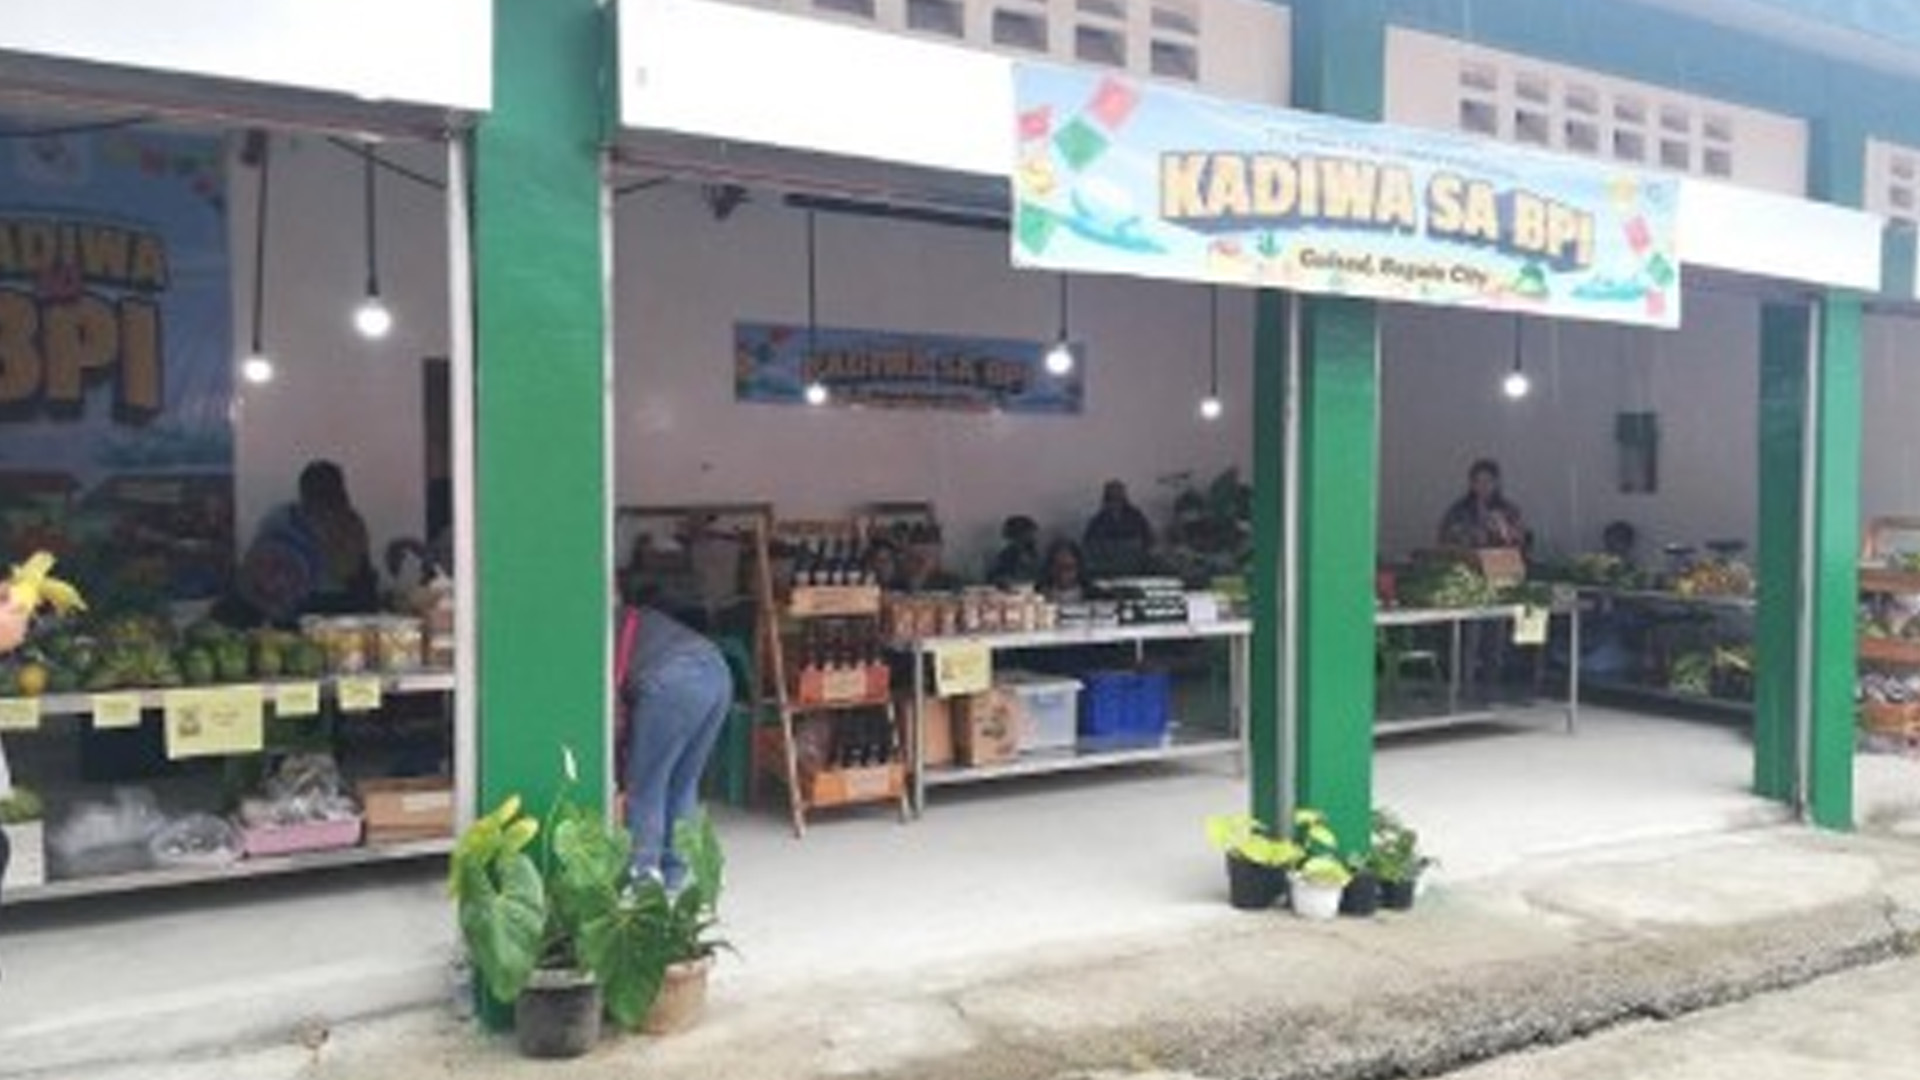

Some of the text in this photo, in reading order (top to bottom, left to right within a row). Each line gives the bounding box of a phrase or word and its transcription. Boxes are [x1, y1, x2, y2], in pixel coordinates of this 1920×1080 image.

[1160, 150, 1595, 270] KADIWA SA BPI
[1448, 263, 1488, 291] City
